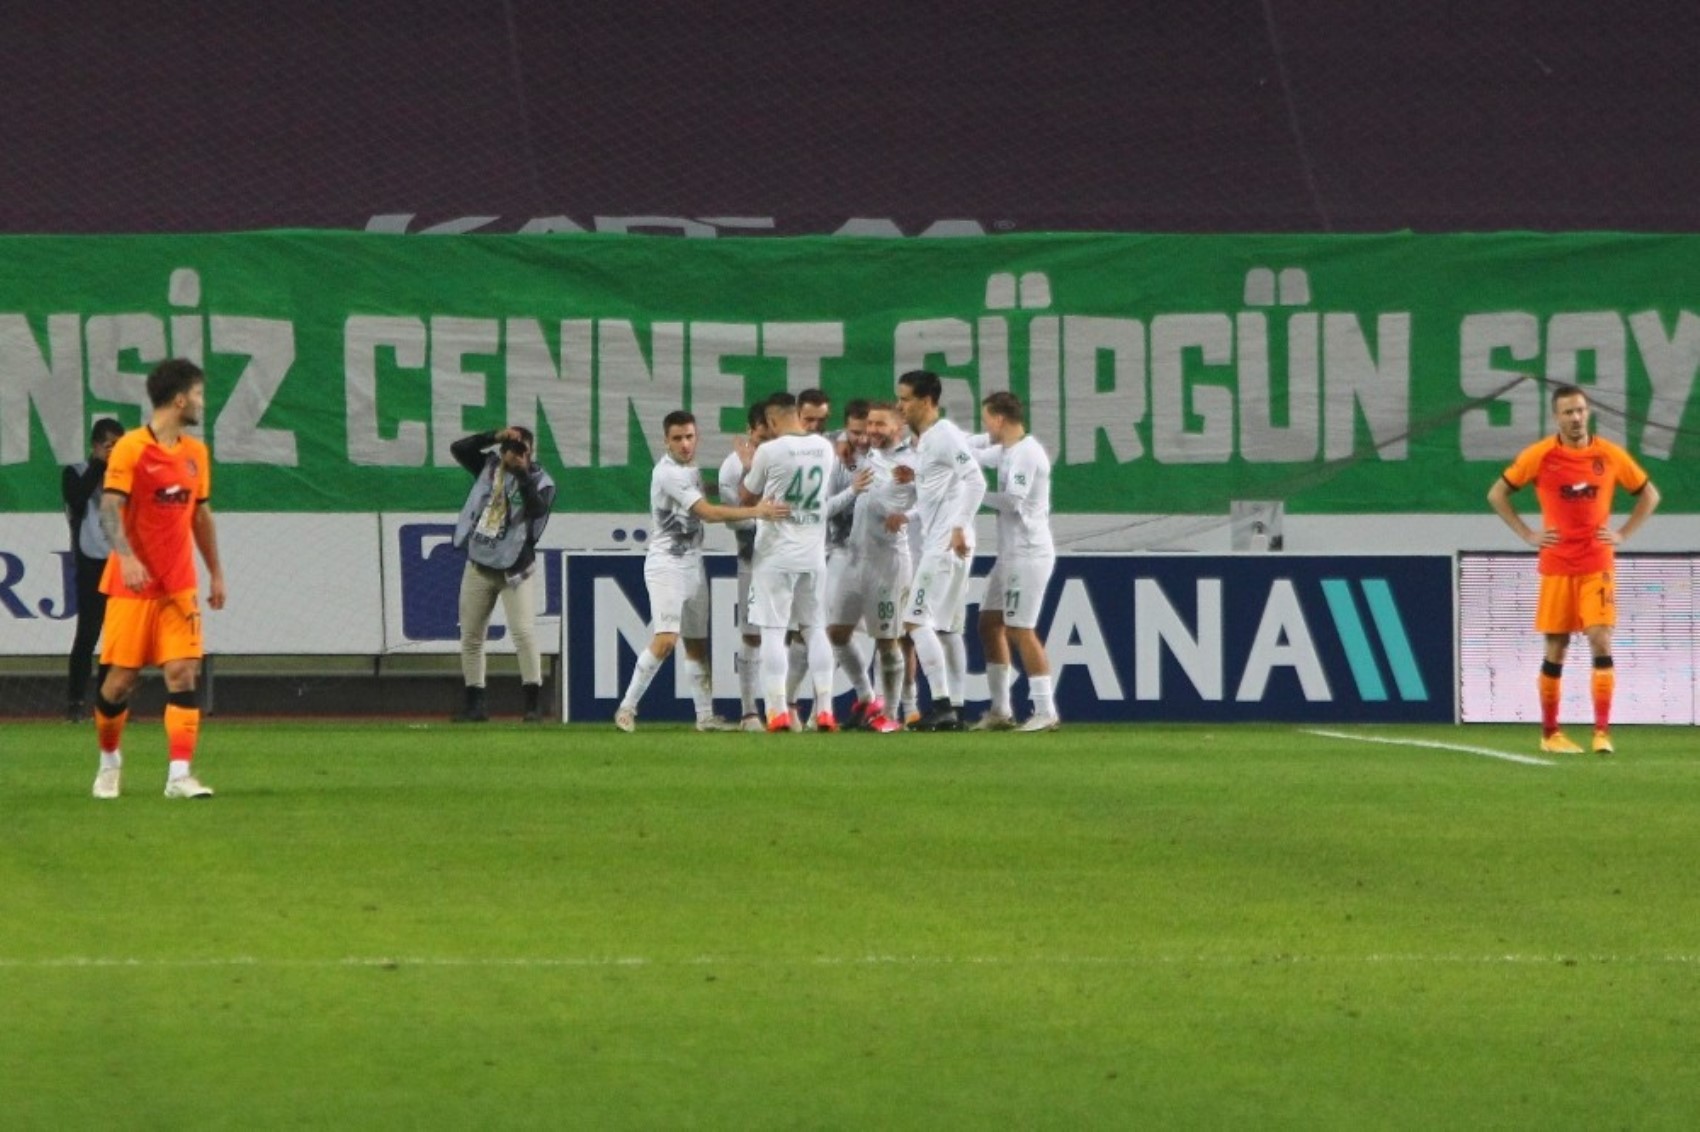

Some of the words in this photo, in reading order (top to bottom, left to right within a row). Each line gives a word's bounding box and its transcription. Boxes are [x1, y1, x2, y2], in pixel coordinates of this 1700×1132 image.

[344, 316, 844, 470] CENNET
[784, 465, 823, 510] 42
[915, 589, 925, 606] 8
[1005, 589, 1021, 608] 11
[878, 600, 895, 620] 89
